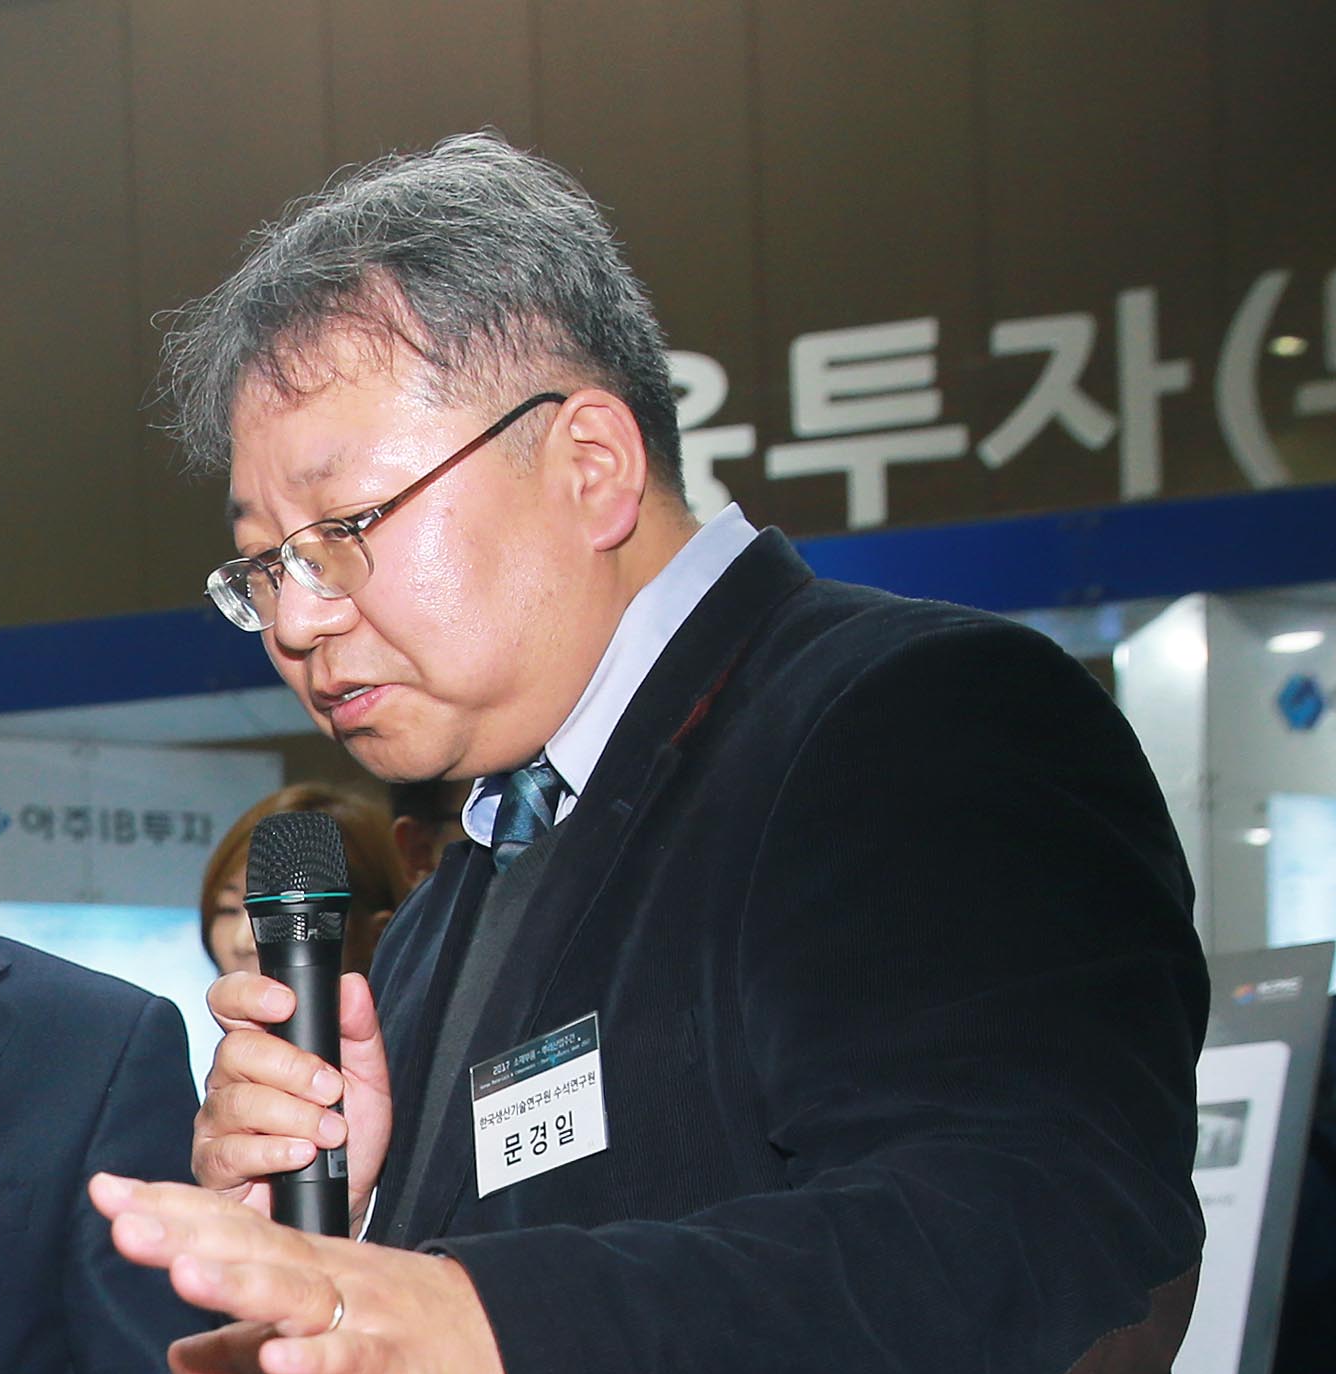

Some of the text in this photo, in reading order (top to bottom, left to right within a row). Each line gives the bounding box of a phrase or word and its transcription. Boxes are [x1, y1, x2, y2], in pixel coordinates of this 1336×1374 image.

[670, 267, 1336, 532] 투자(
[19, 803, 213, 846] 아주IB투자
[479, 1071, 596, 1130] 한국생산기술연구원 수석연구원
